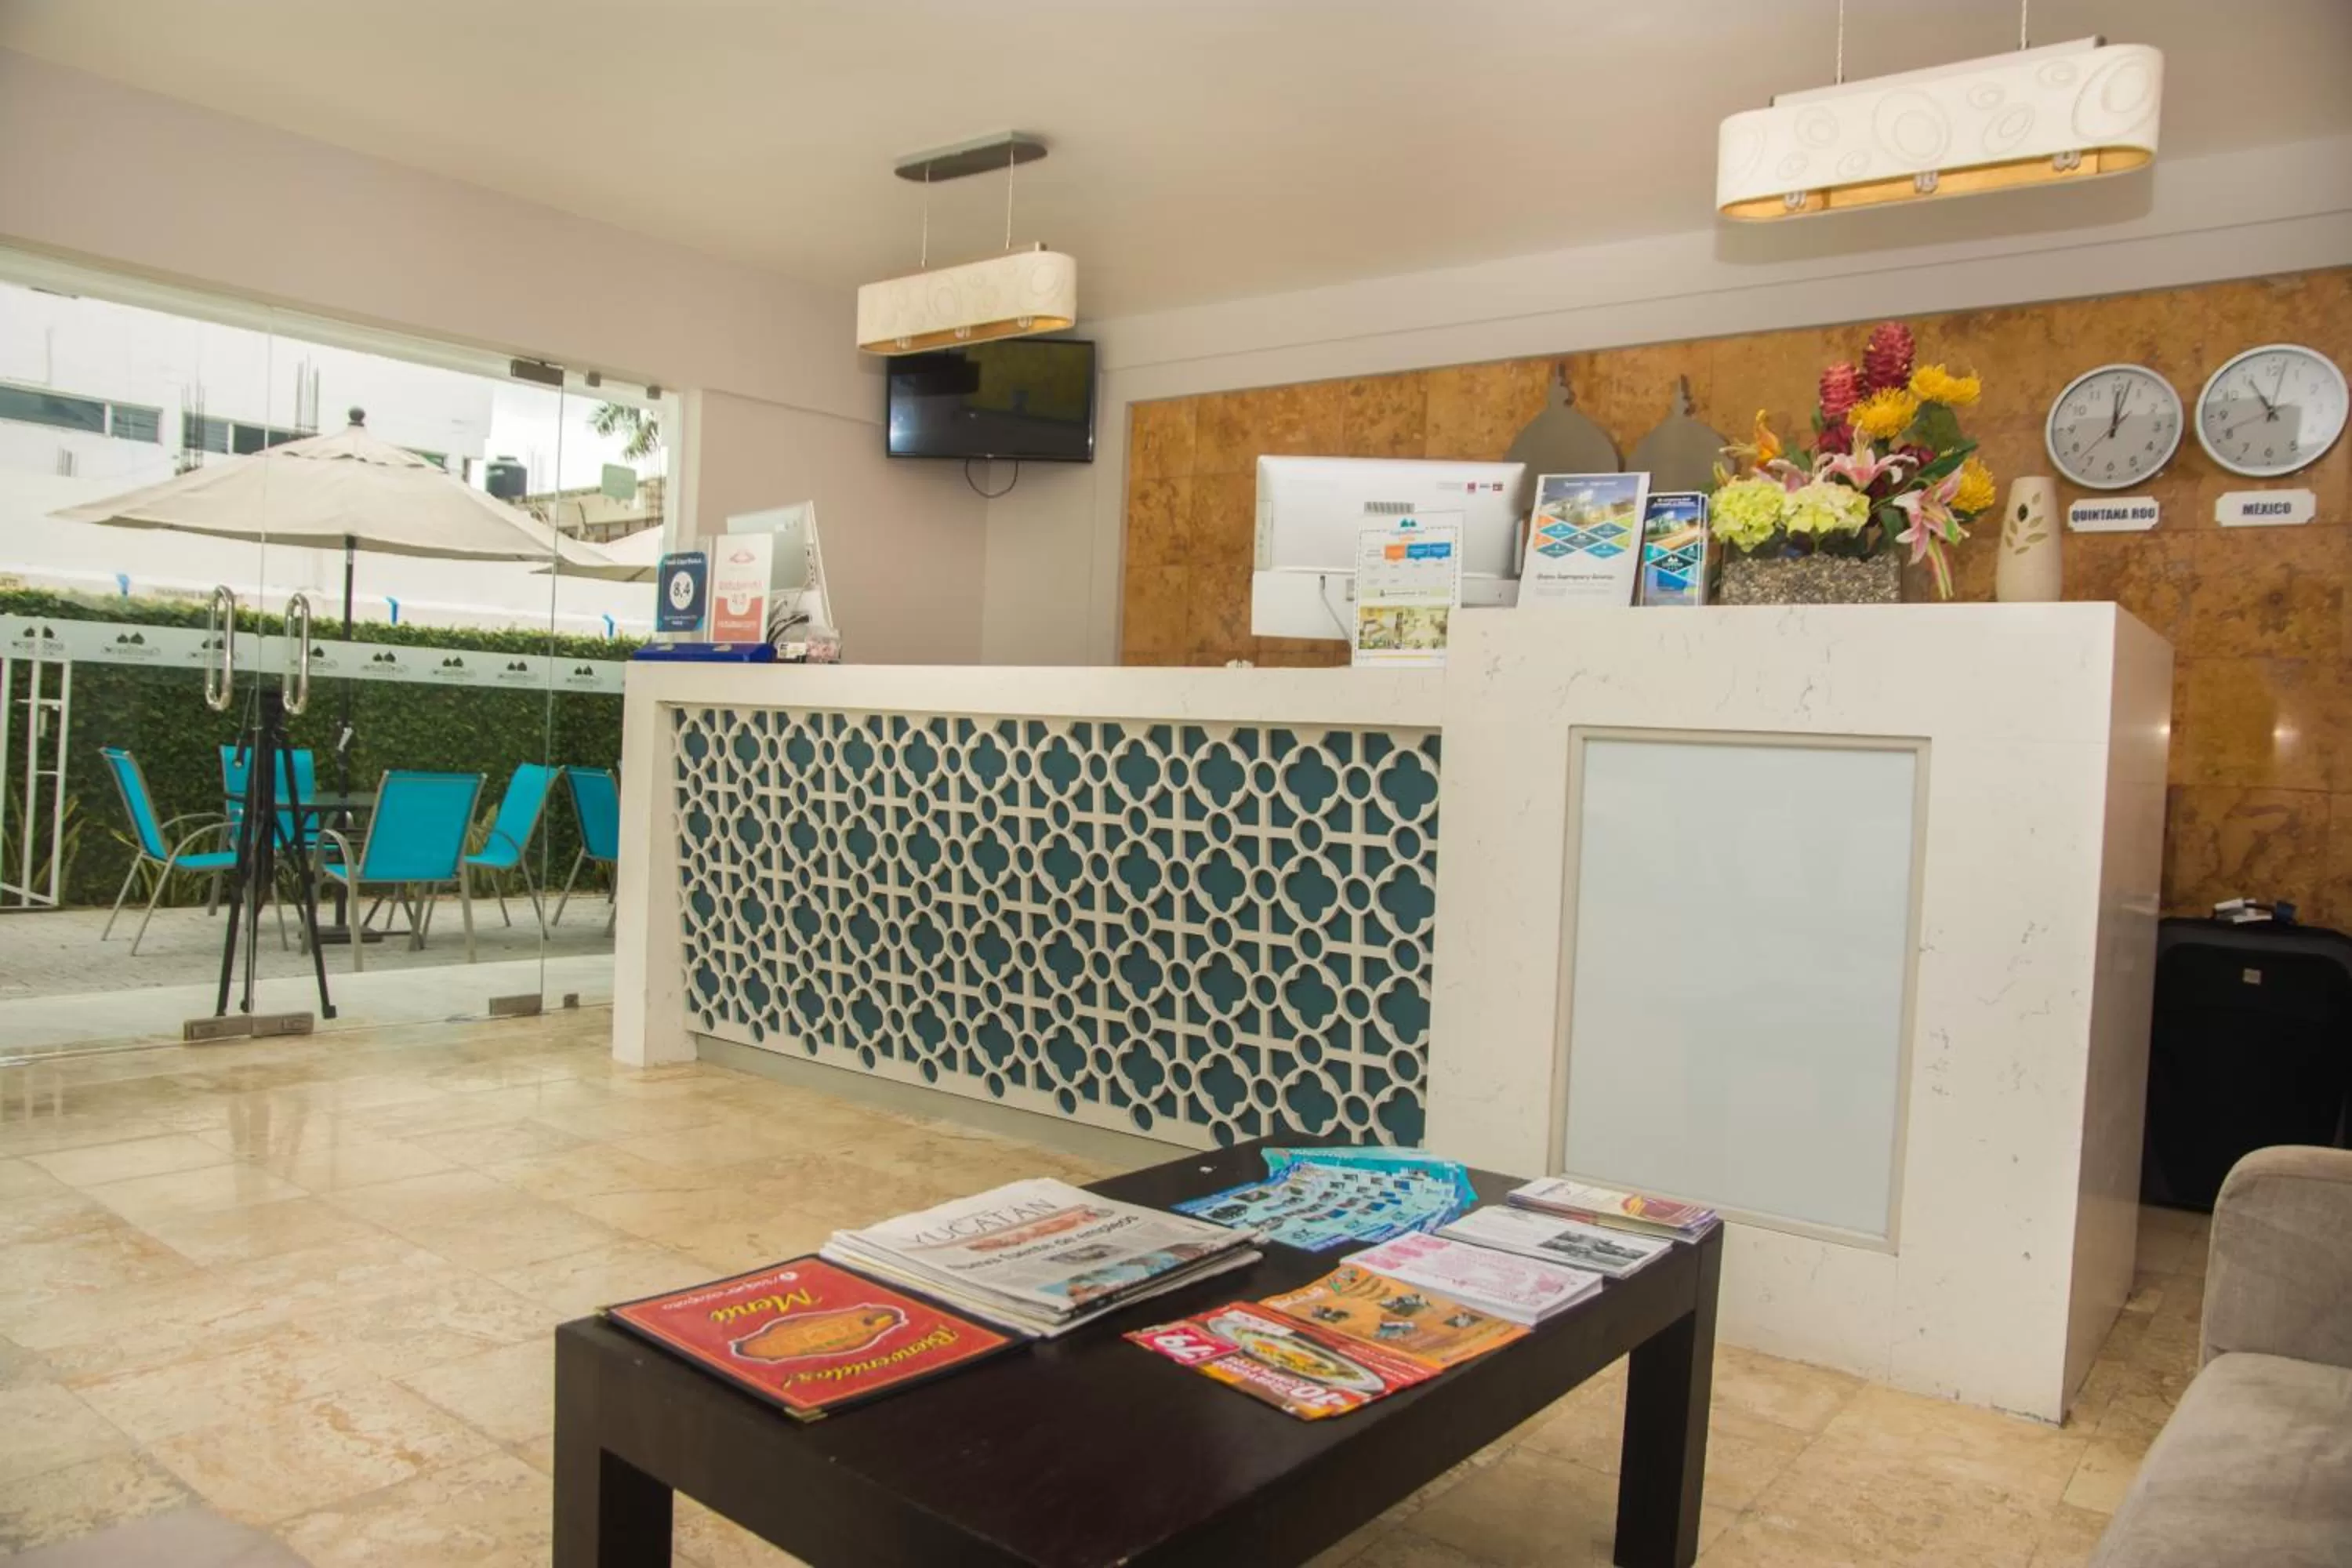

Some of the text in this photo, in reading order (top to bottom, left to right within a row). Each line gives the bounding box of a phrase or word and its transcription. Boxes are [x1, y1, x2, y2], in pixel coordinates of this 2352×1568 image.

[2074, 405, 2087, 415] 10
[2071, 507, 2155, 522] QUINTANA ROO
